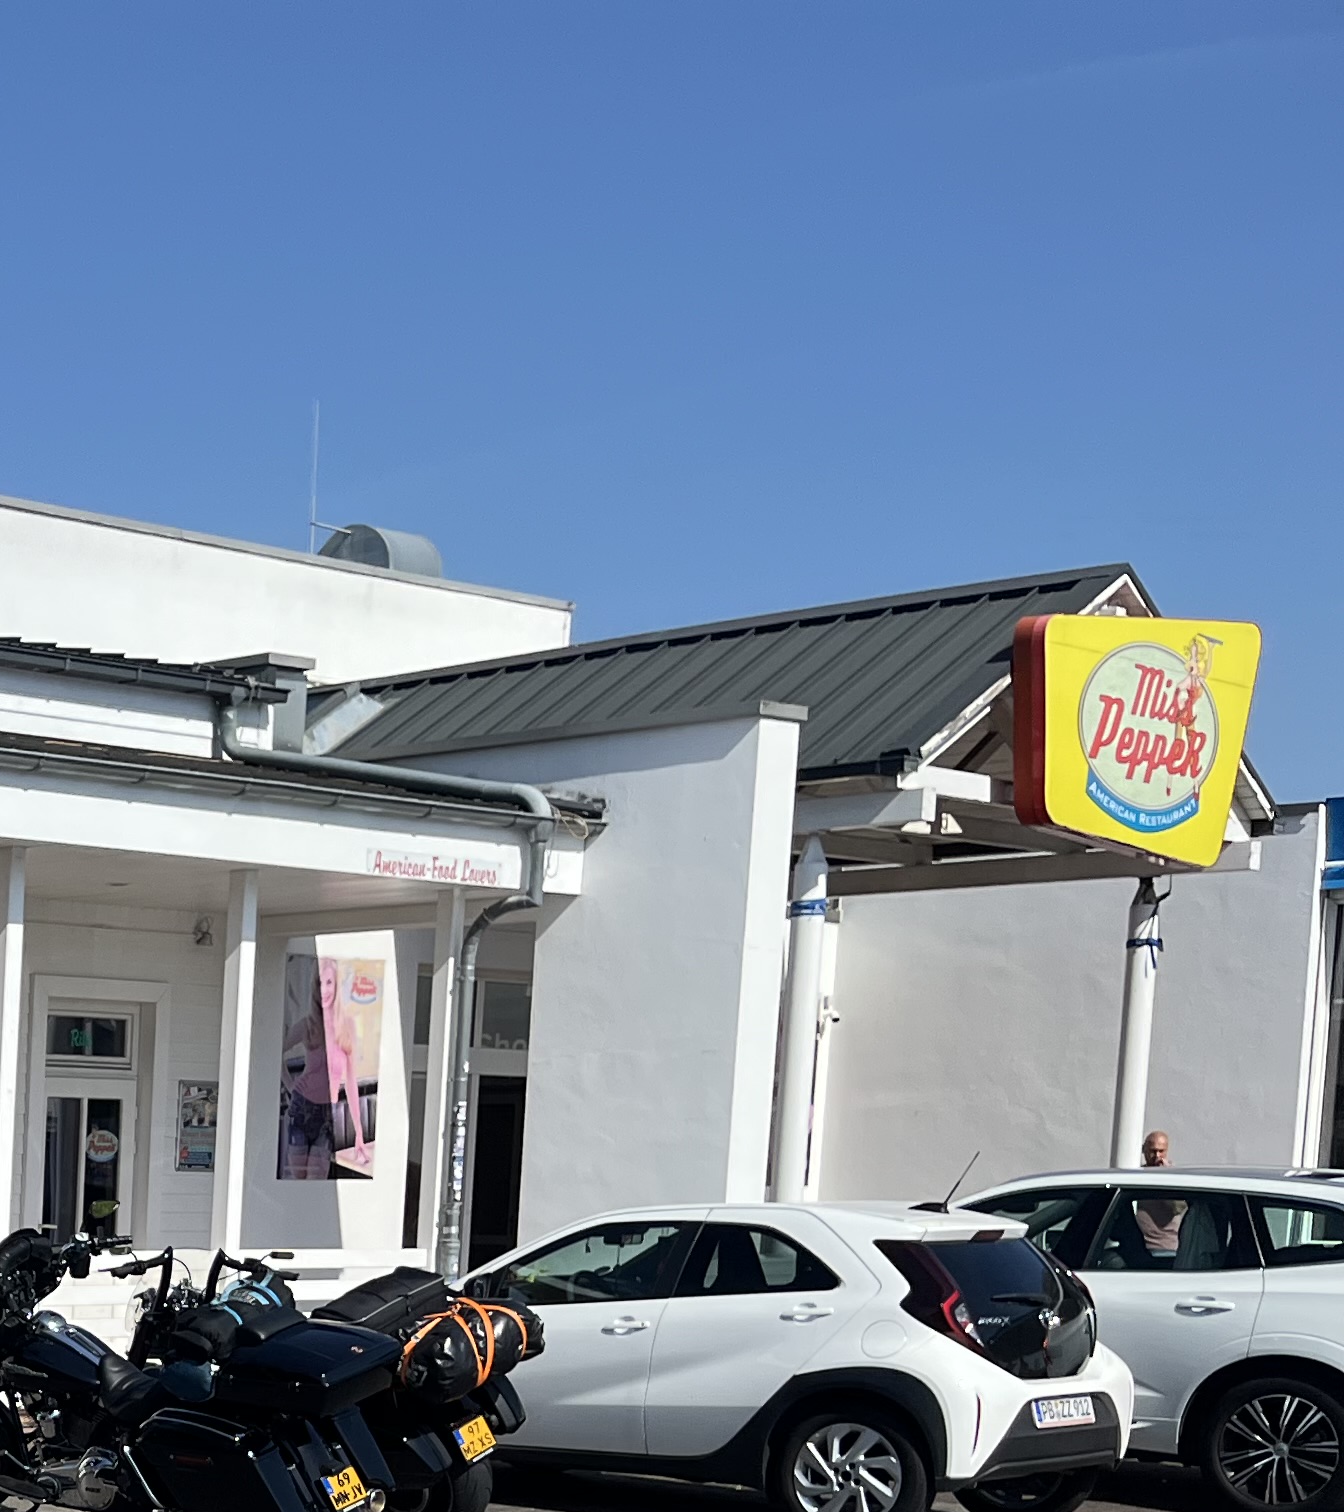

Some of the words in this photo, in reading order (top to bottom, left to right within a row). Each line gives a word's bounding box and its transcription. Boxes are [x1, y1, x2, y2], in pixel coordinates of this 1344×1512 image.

[1131, 663, 1198, 727] Miss
[1088, 782, 1137, 823] AMERICAN
[1139, 799, 1197, 827] RESTAURANT
[373, 851, 458, 880] American-Food
[461, 859, 497, 885] Lovers
[1041, 1402, 1055, 1420] PB
[467, 1421, 480, 1437] 97
[337, 1472, 351, 1487] 69
